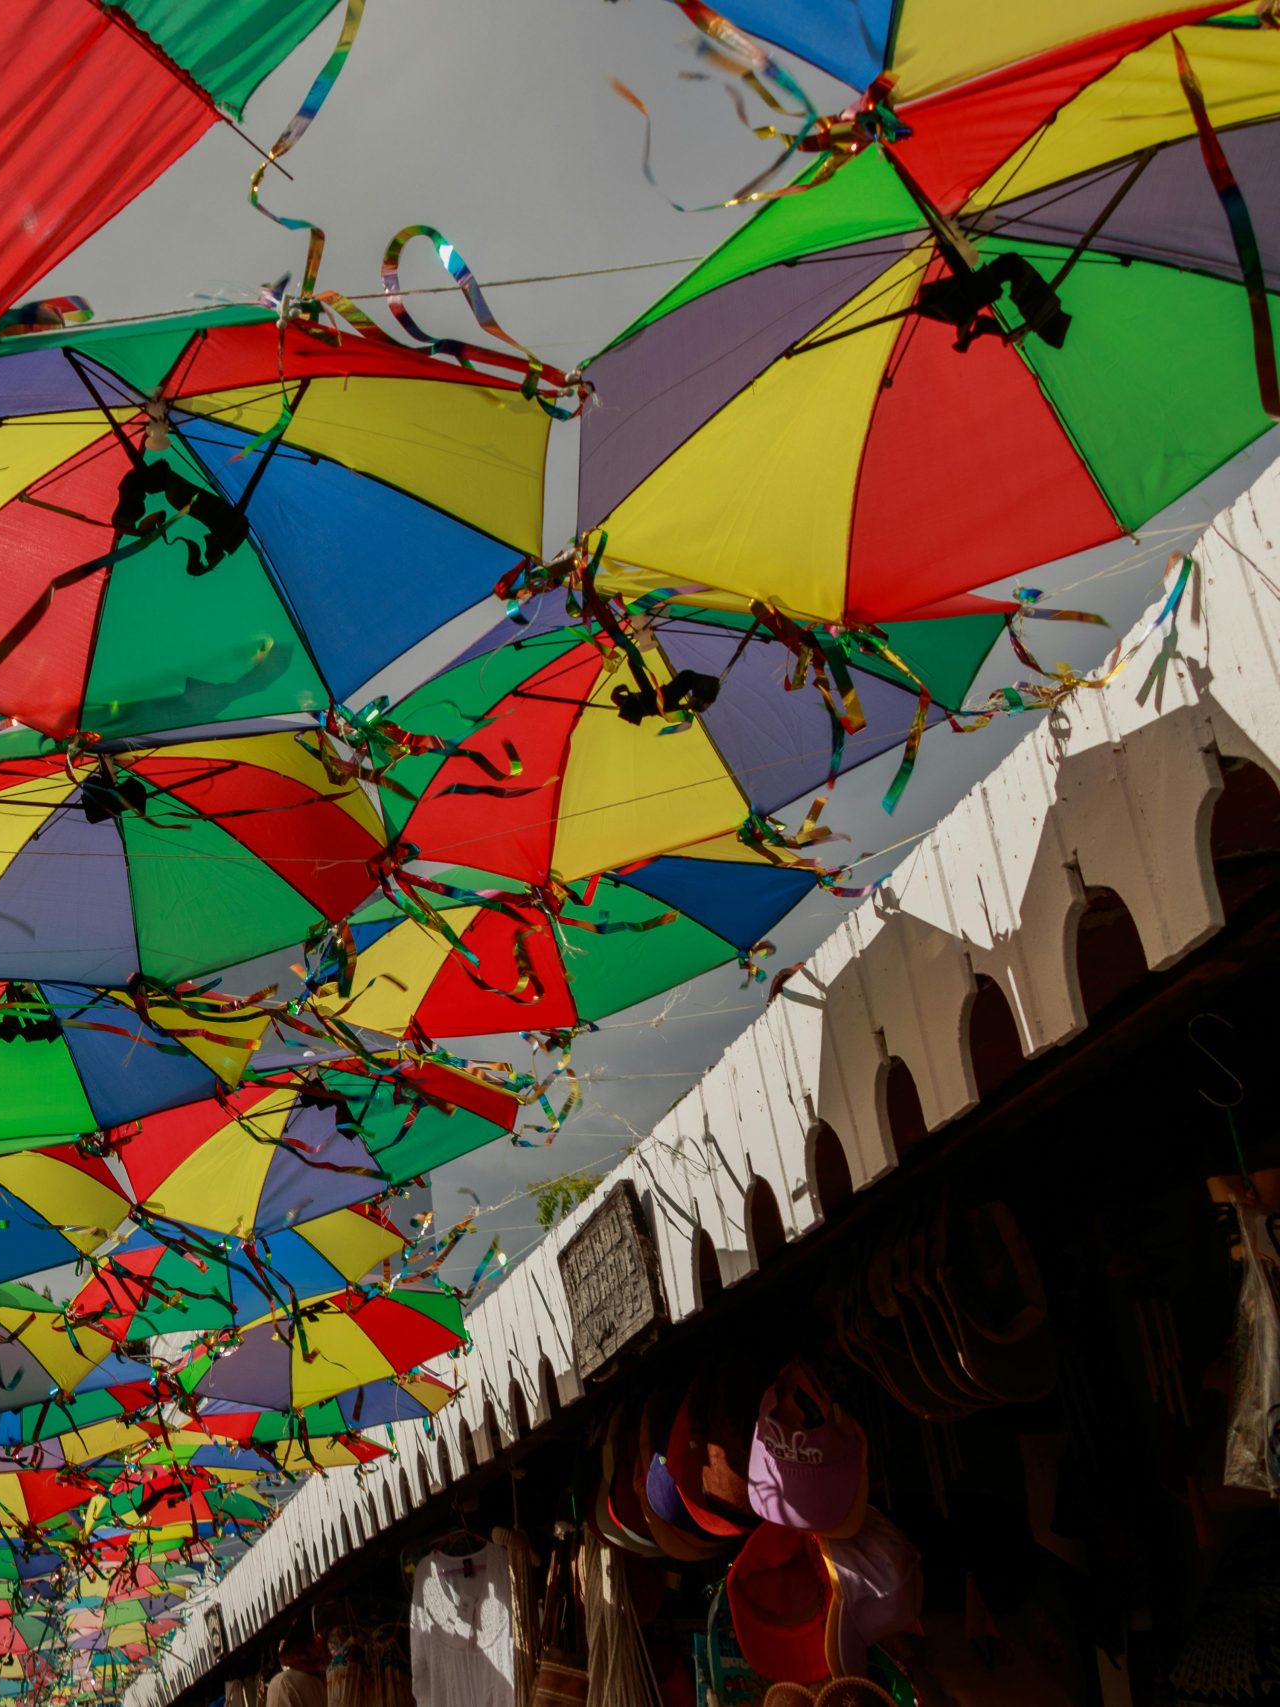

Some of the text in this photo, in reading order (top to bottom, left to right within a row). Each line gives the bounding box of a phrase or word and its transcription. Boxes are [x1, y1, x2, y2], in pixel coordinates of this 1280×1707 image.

[563, 1208, 623, 1292] RICARDO
[573, 1240, 636, 1325] ANDRADE
[764, 1431, 823, 1464] Rabbit
